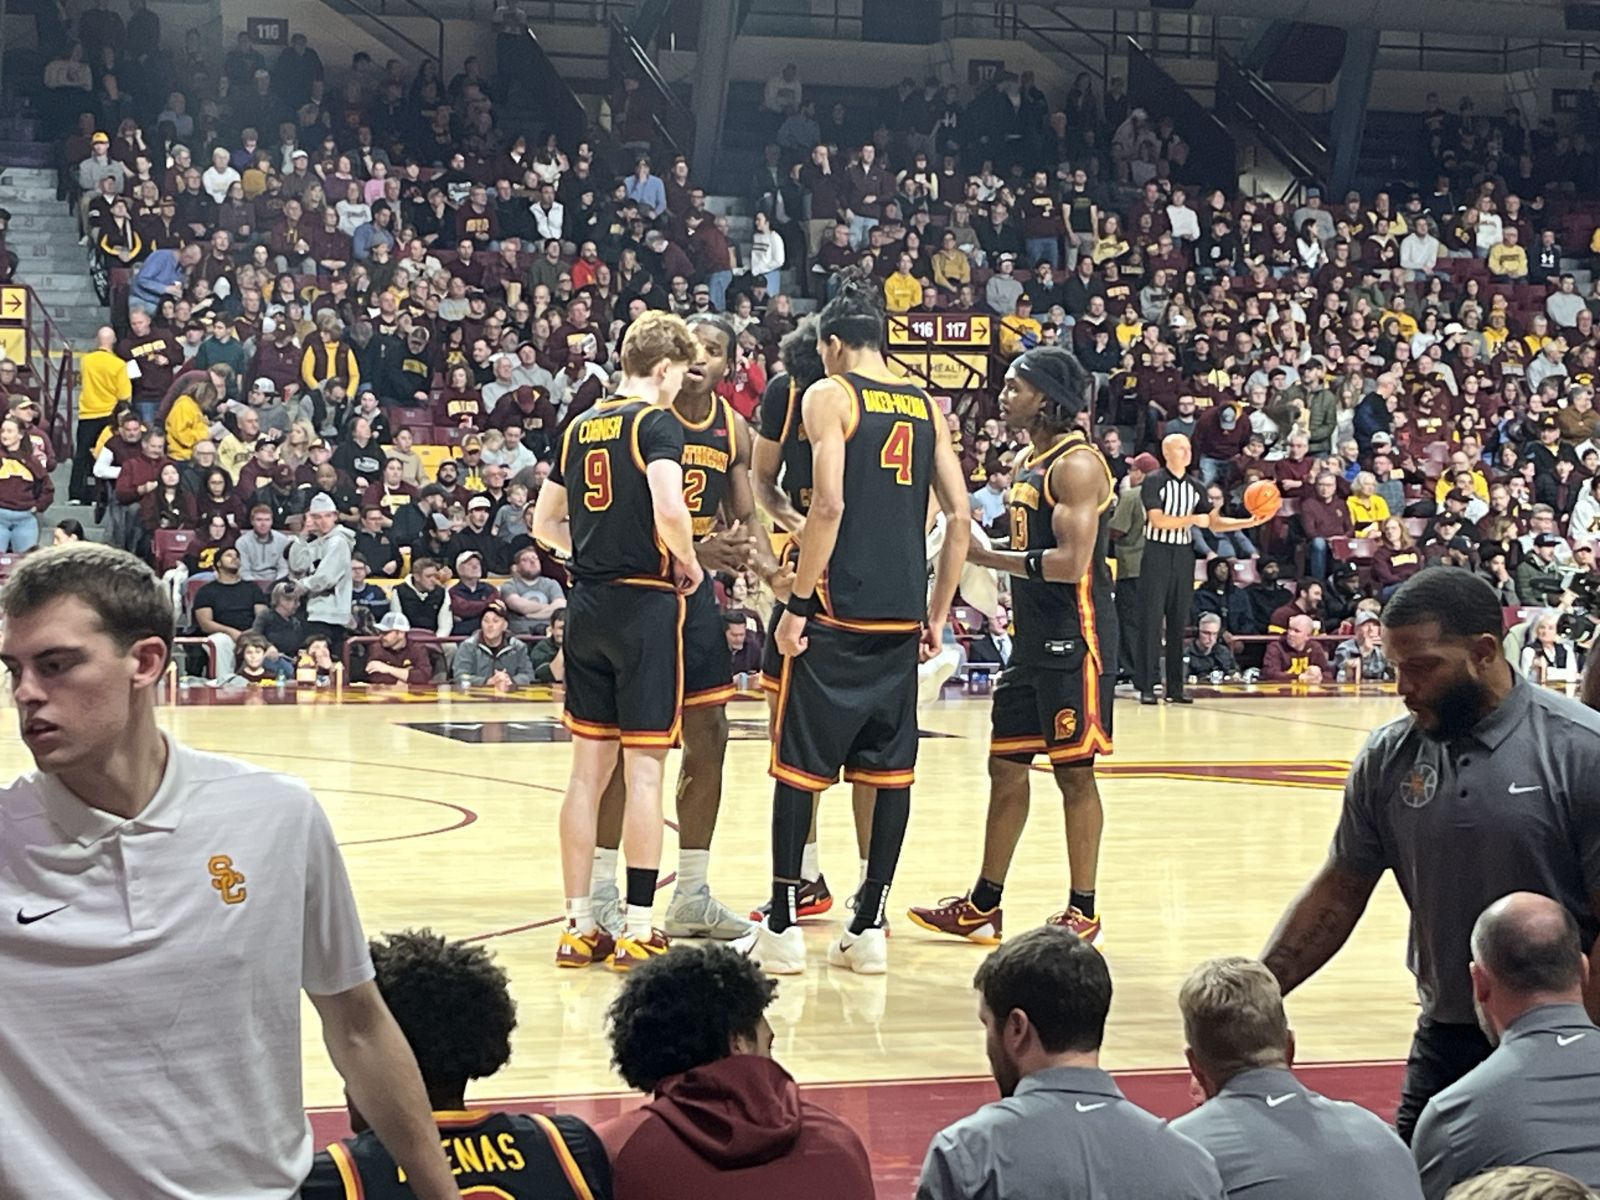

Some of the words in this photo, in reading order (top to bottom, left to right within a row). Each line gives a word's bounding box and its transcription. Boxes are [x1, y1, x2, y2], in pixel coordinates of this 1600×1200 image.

[256, 23, 280, 40] 116
[912, 321, 934, 338] 116
[945, 321, 967, 338] 117
[881, 421, 914, 486] 4
[584, 448, 613, 512] 9
[683, 469, 707, 512] 2
